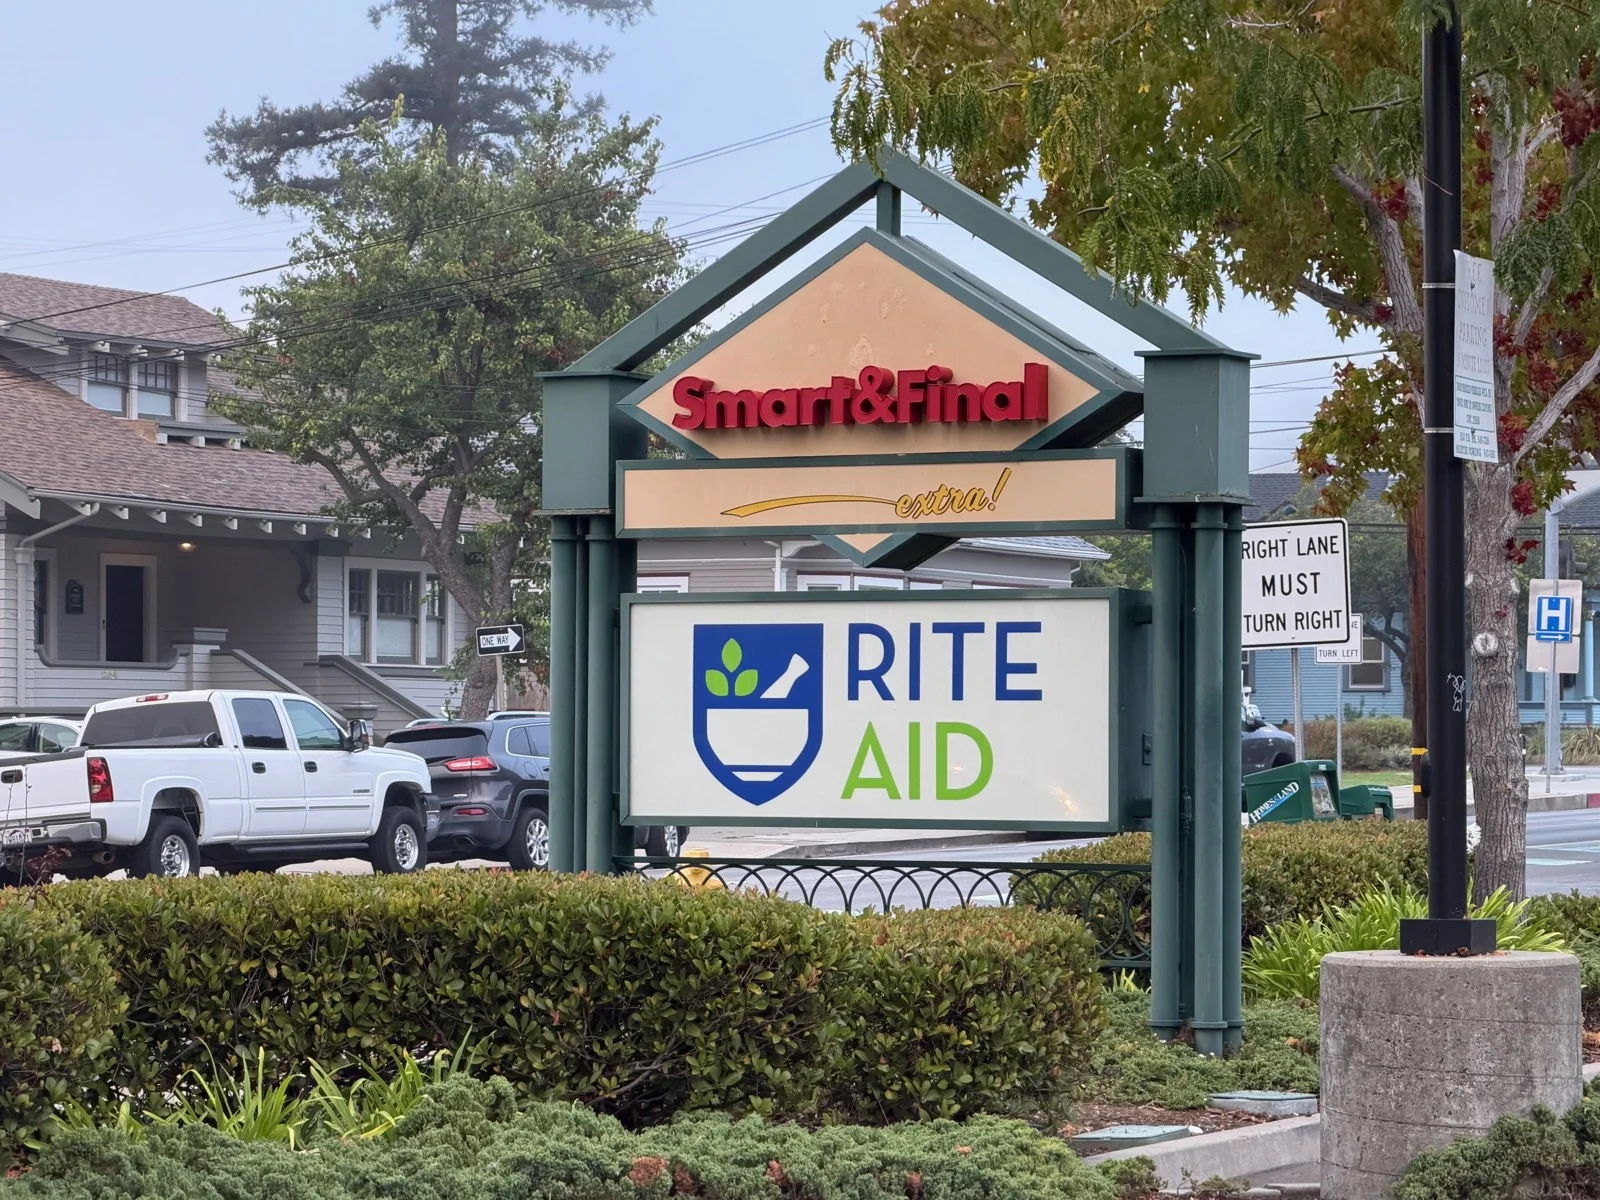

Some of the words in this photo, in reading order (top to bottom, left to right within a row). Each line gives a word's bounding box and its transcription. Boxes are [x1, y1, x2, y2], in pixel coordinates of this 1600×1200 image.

[671, 363, 1048, 431] Smart&Final
[894, 467, 1012, 519] extra!
[1242, 538, 1288, 560] RIGHT
[1297, 535, 1339, 556] LANE
[1261, 572, 1320, 597] MUST
[1243, 612, 1287, 633] TURN
[1295, 609, 1342, 630] RIGHT
[1541, 598, 1566, 630] H
[481, 636, 495, 647] ONE
[497, 635, 509, 645] WAY
[1319, 649, 1337, 658] TURN
[1342, 649, 1359, 658] LEFT
[848, 621, 1042, 701] RITE
[840, 720, 994, 801] AID
